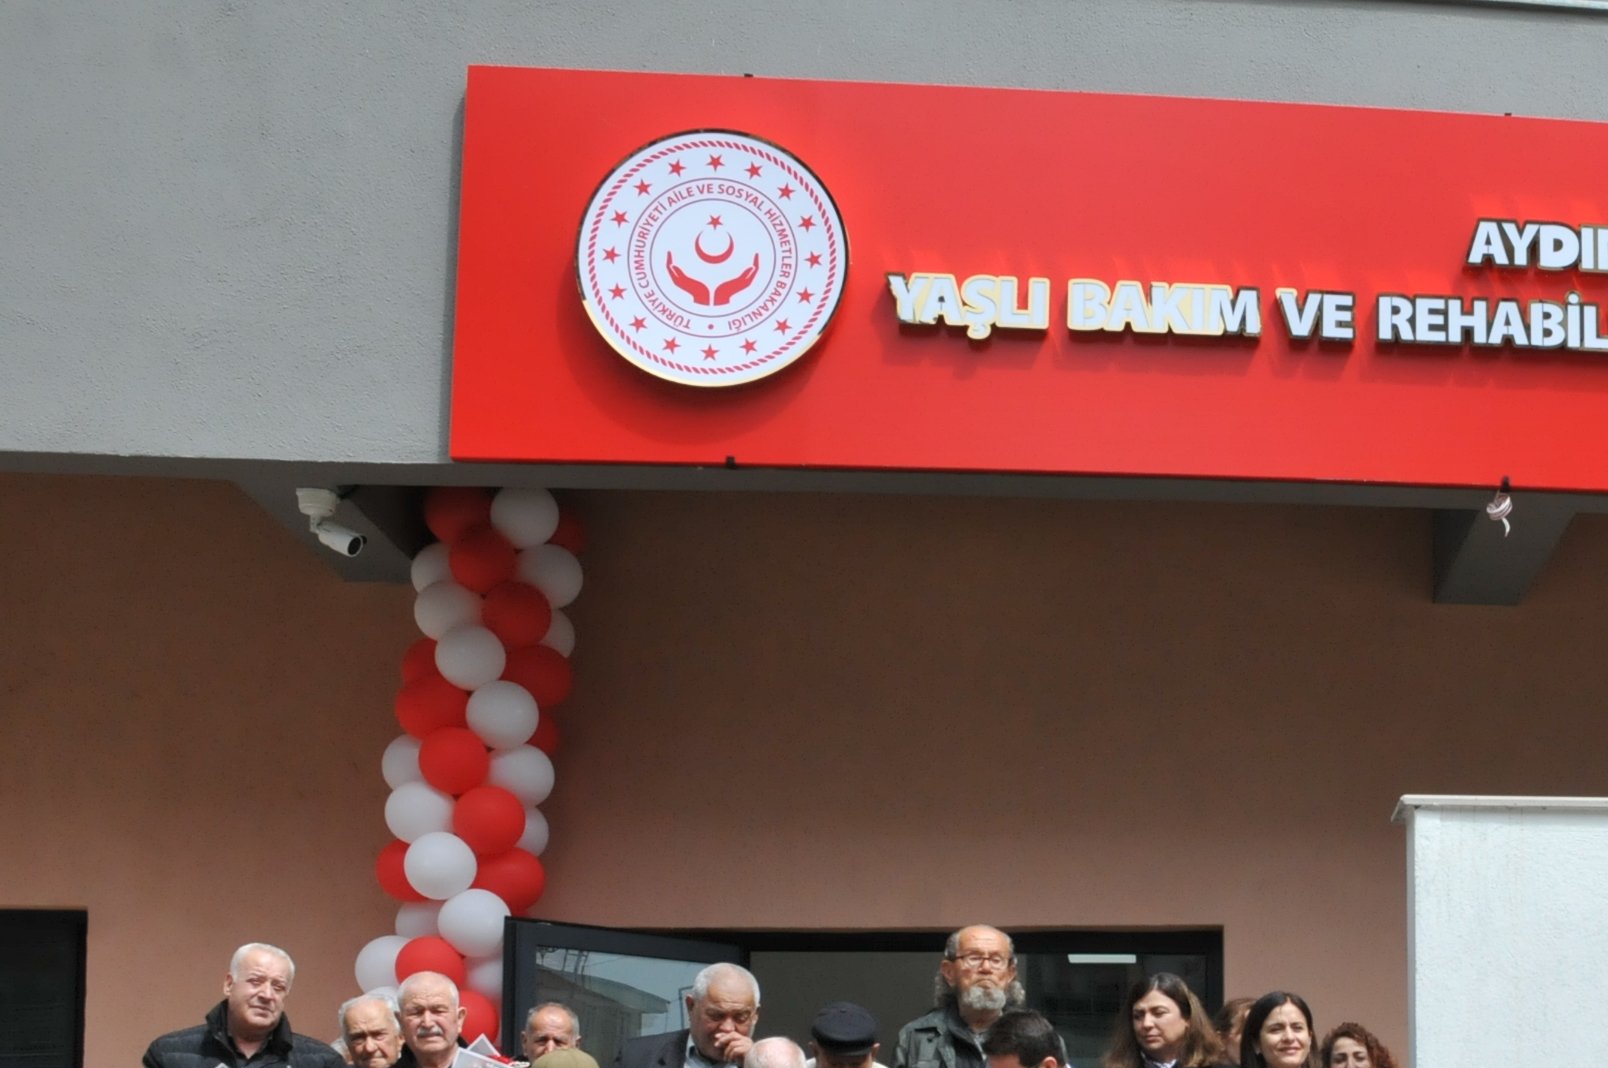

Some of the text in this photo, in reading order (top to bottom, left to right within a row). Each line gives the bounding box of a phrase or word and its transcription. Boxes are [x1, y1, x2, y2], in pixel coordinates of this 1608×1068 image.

[633, 183, 793, 332] TÜRKİYE CUMHURİYETİ AİLE VE SOSYAL HİZMETLER BAKANLIĞI
[886, 273, 1050, 340] YAŞLI
[1067, 279, 1262, 337] BAKIM
[1276, 288, 1355, 341] VE
